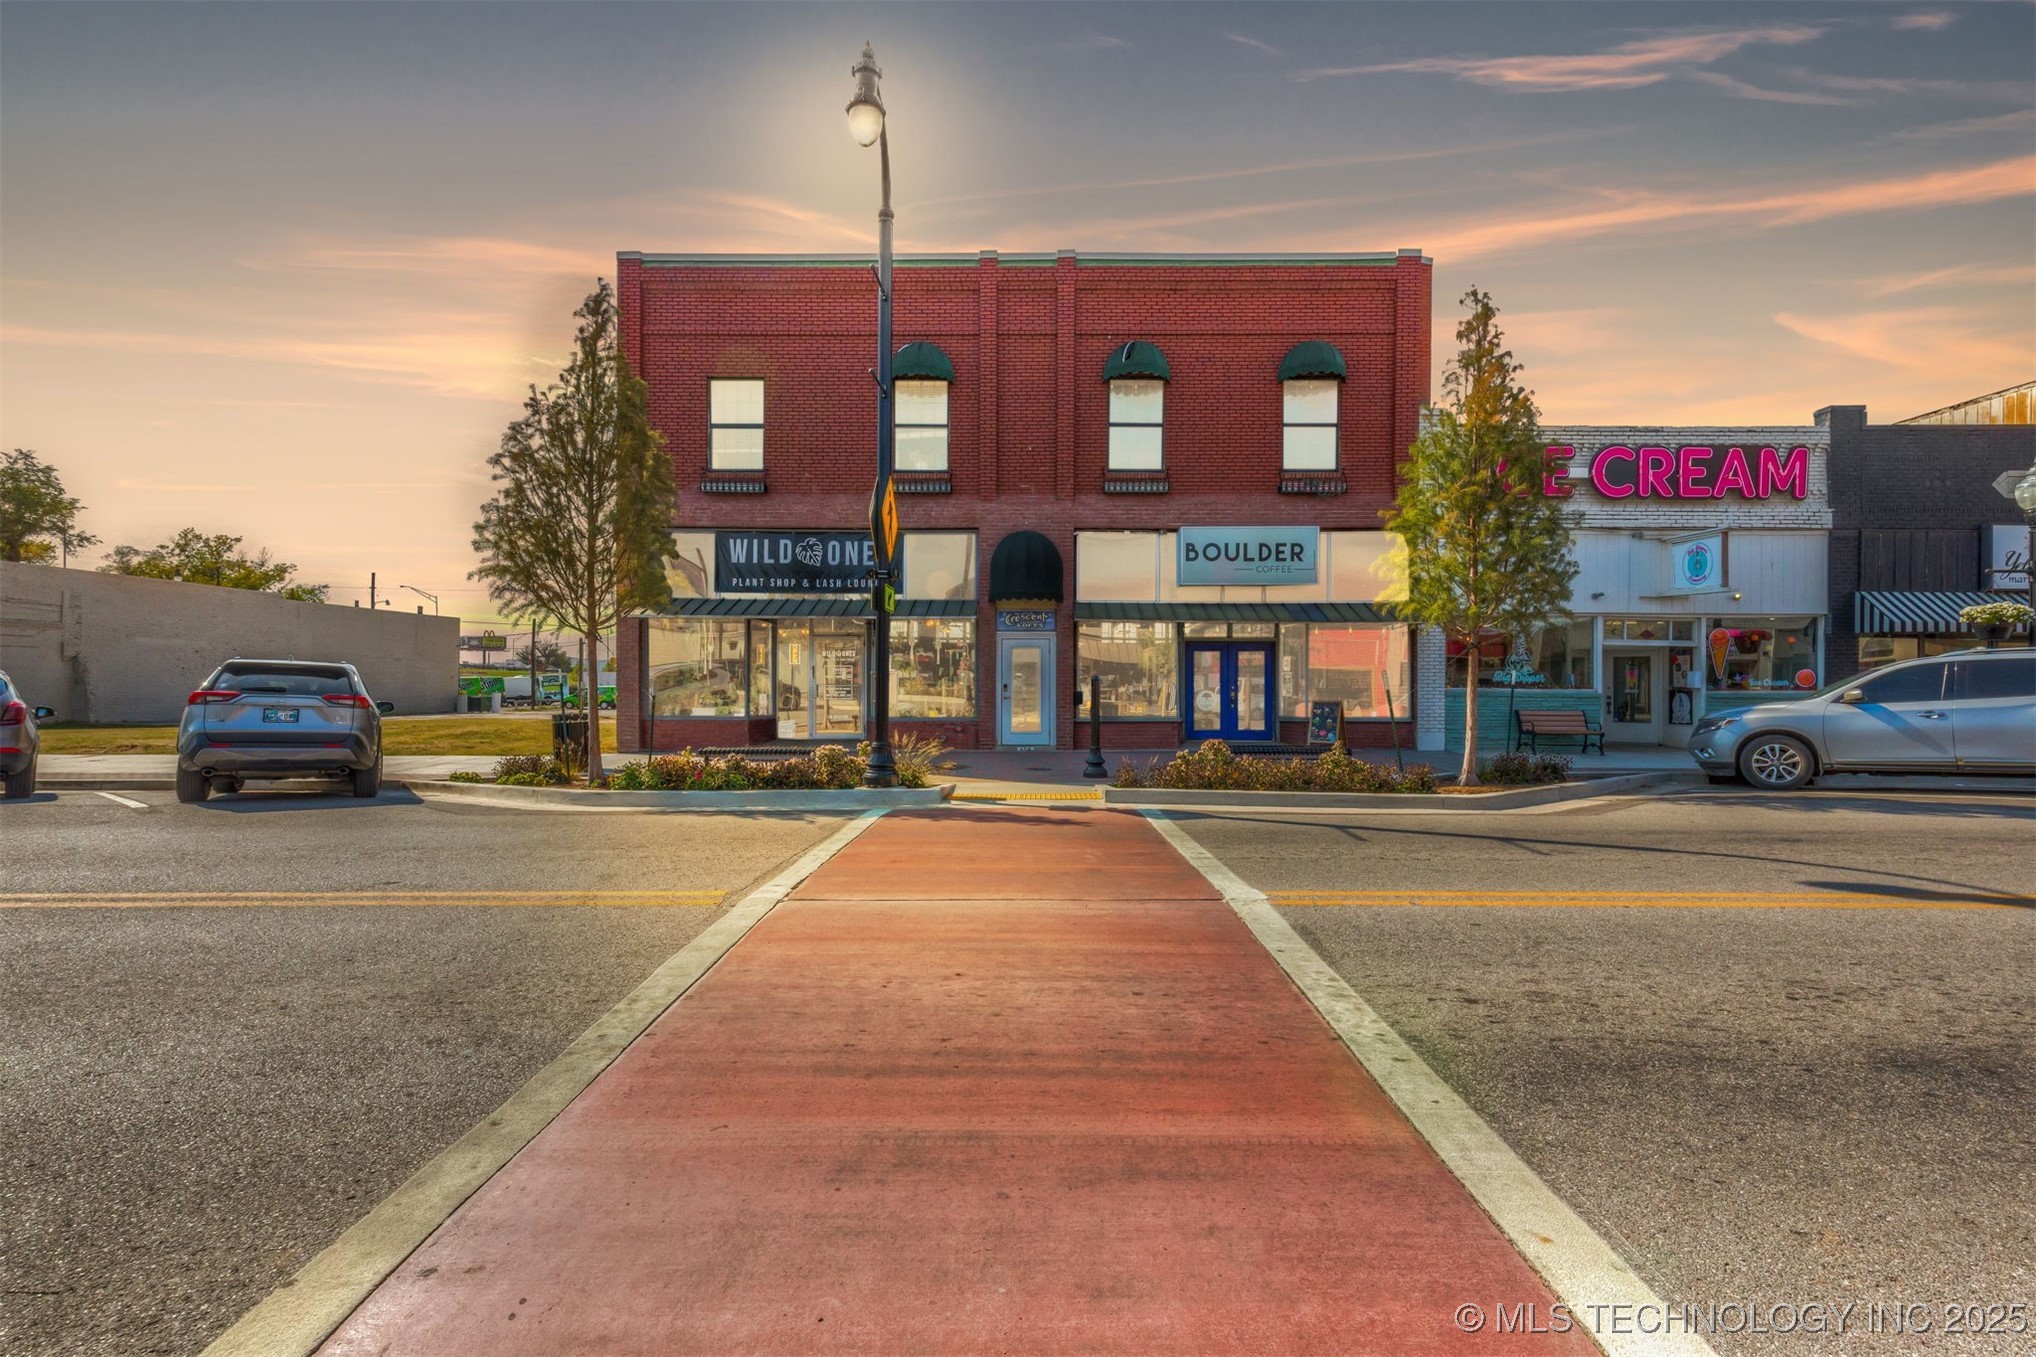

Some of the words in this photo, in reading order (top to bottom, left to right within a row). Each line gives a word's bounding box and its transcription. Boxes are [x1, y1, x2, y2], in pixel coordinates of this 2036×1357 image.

[1592, 446, 1809, 498] CREAM
[729, 538, 793, 564] WILD
[827, 540, 876, 566] ONE
[1185, 542, 1304, 562] BOULDER
[1256, 565, 1293, 573] COFFEE
[732, 577, 765, 587] PLANT
[770, 578, 796, 587] SHOP
[802, 579, 810, 588] &
[816, 578, 842, 588] LASH
[1004, 612, 1048, 626] Crescent
[1493, 670, 1511, 684] Big
[1514, 671, 1546, 684] Dipper
